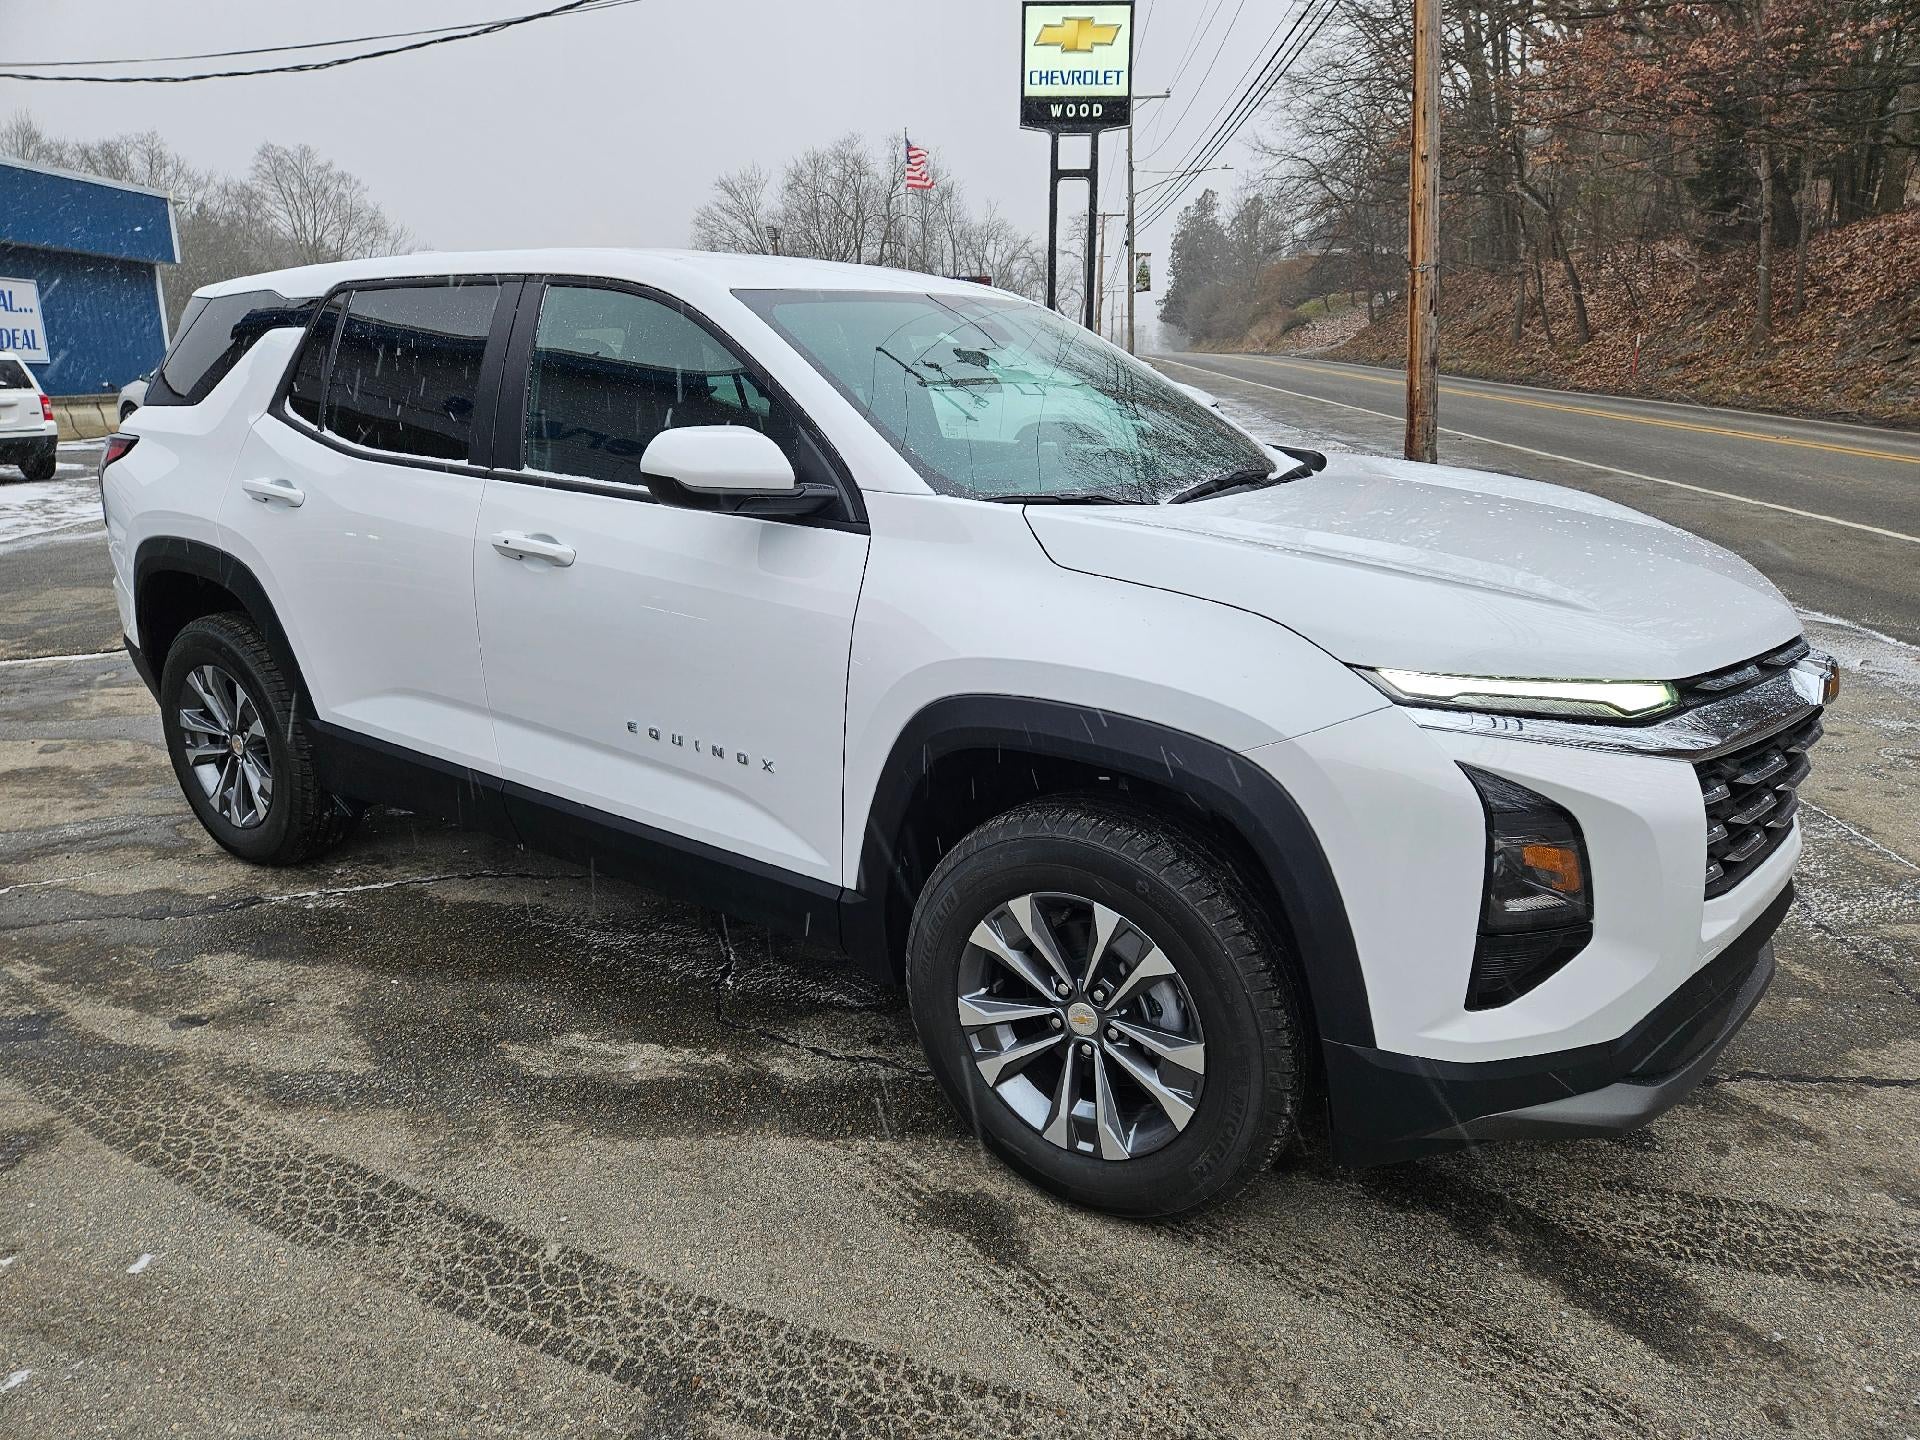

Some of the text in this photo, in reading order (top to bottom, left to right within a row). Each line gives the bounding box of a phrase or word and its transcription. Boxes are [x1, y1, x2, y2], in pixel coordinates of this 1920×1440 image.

[1029, 70, 1124, 86] CHEVROLET
[1050, 103, 1103, 118] WOOD
[0, 327, 41, 351] DEAL
[627, 720, 775, 774] EQUINOX
